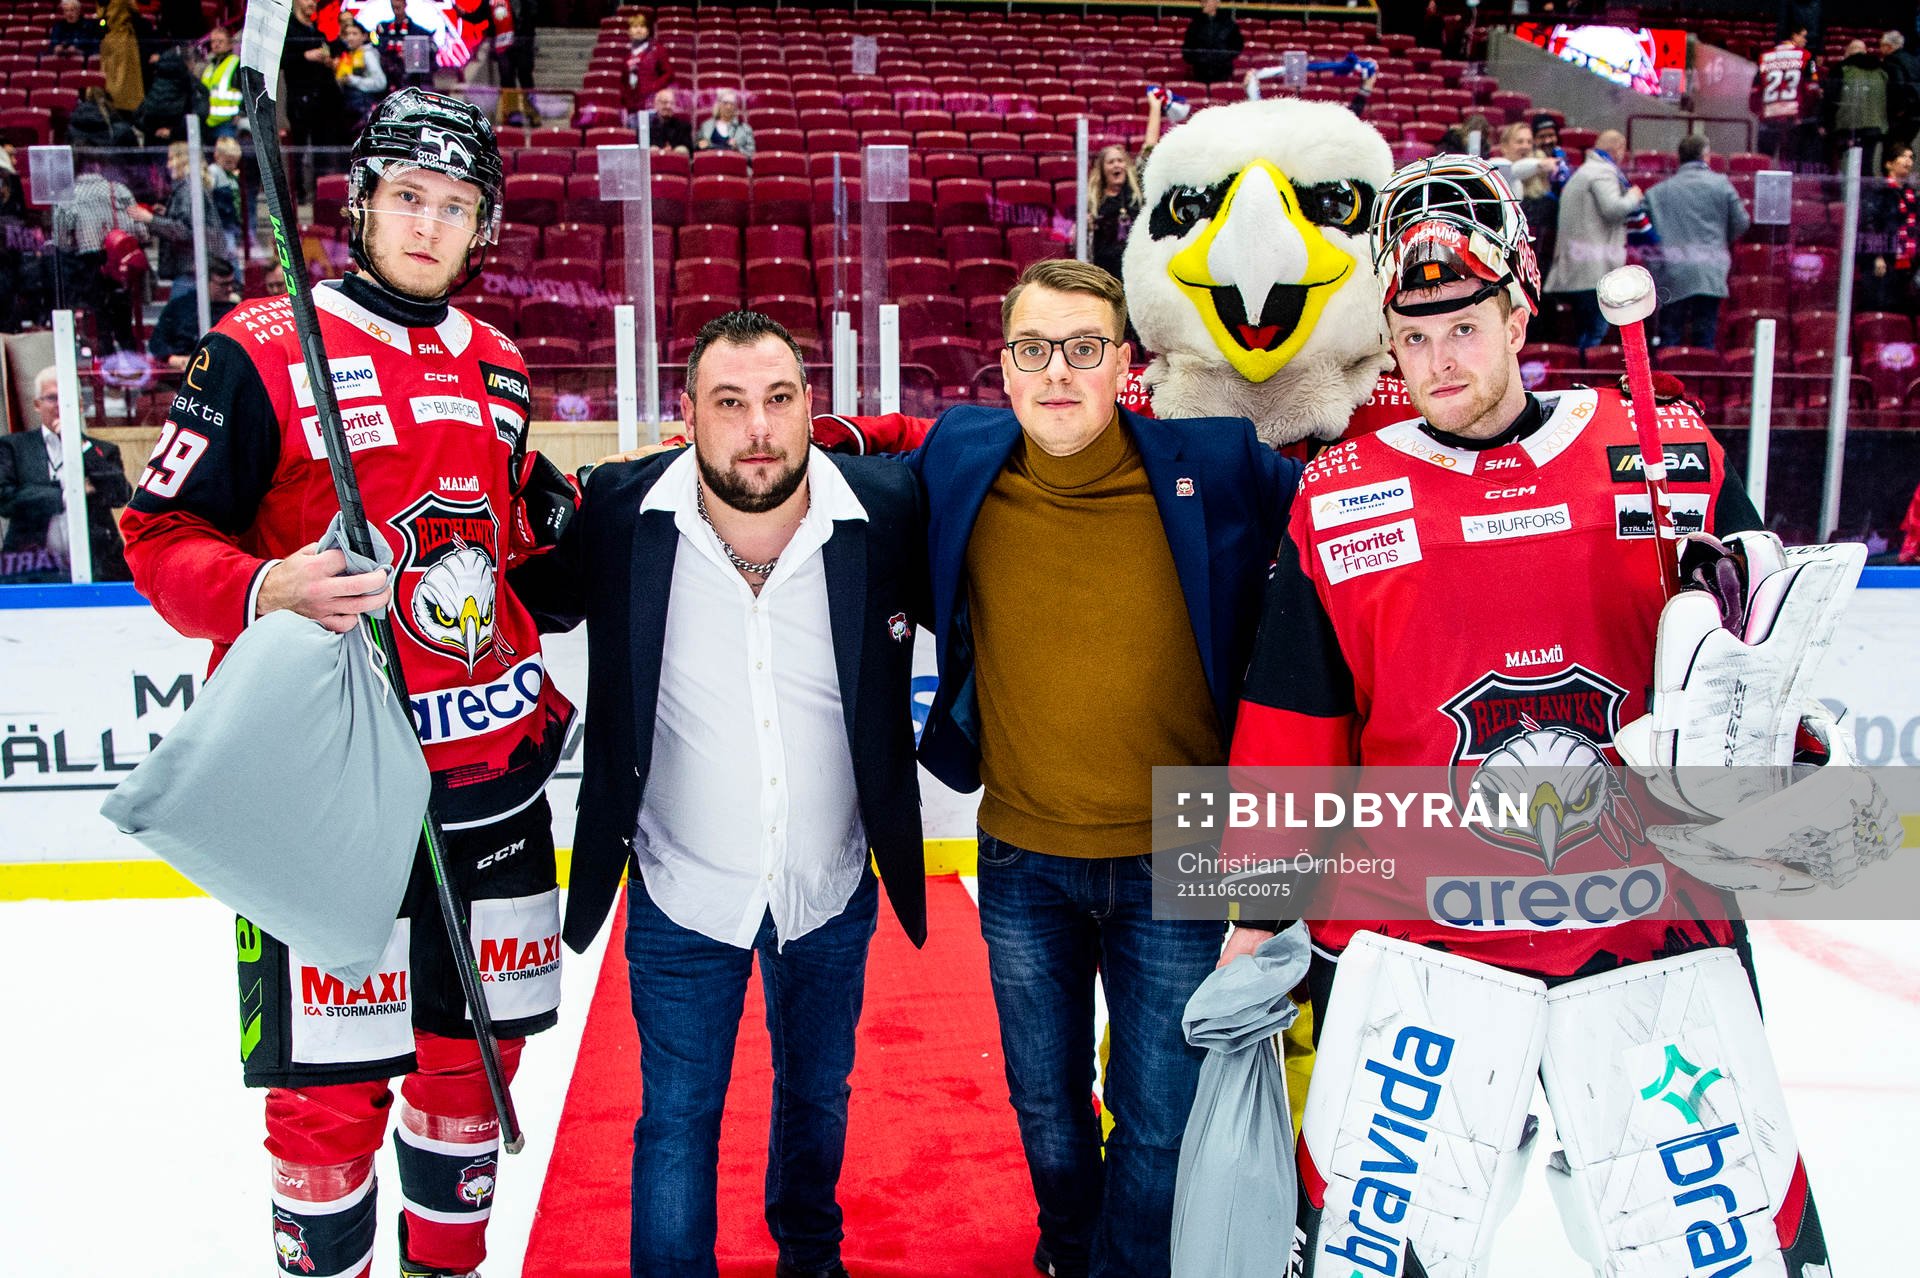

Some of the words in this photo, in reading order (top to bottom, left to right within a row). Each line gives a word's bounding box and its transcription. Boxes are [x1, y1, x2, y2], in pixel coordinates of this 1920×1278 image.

[1764, 70, 1801, 103] 23
[416, 157, 469, 176] MAGNUSSON
[417, 150, 440, 161] OTTO
[269, 214, 298, 297] CCM
[245, 308, 295, 332] AREN
[254, 319, 297, 345] HOT
[417, 343, 444, 355] SHL
[329, 368, 373, 384] REANO
[424, 372, 459, 384] CCM
[497, 375, 530, 404] RSA
[1116, 393, 1149, 405] HOT
[1366, 394, 1411, 406] OTEL
[172, 395, 225, 428] akta
[433, 401, 480, 420] BJURFORS
[1484, 457, 1522, 471] SHL
[438, 475, 480, 492] MALMÖ
[1484, 485, 1538, 500] CCM
[1338, 487, 1405, 507] TREANO
[1486, 511, 1566, 535] BJURFORS
[1329, 527, 1406, 562] Prioritet
[1342, 549, 1399, 574] Finans
[1505, 644, 1564, 668] MALMÖ
[409, 662, 544, 741] areco
[1471, 691, 1606, 747] REDHAWKS
[476, 838, 527, 870] CCM
[1432, 868, 1660, 927] areco
[479, 931, 560, 973] MAXI
[498, 960, 560, 983] STORMARKNAD
[301, 966, 408, 1006] MAXI
[304, 1006, 323, 1017] ICA
[326, 1002, 408, 1018] STORMARKNAD
[463, 1117, 500, 1133] CCM
[1324, 1025, 1456, 1278] bravida
